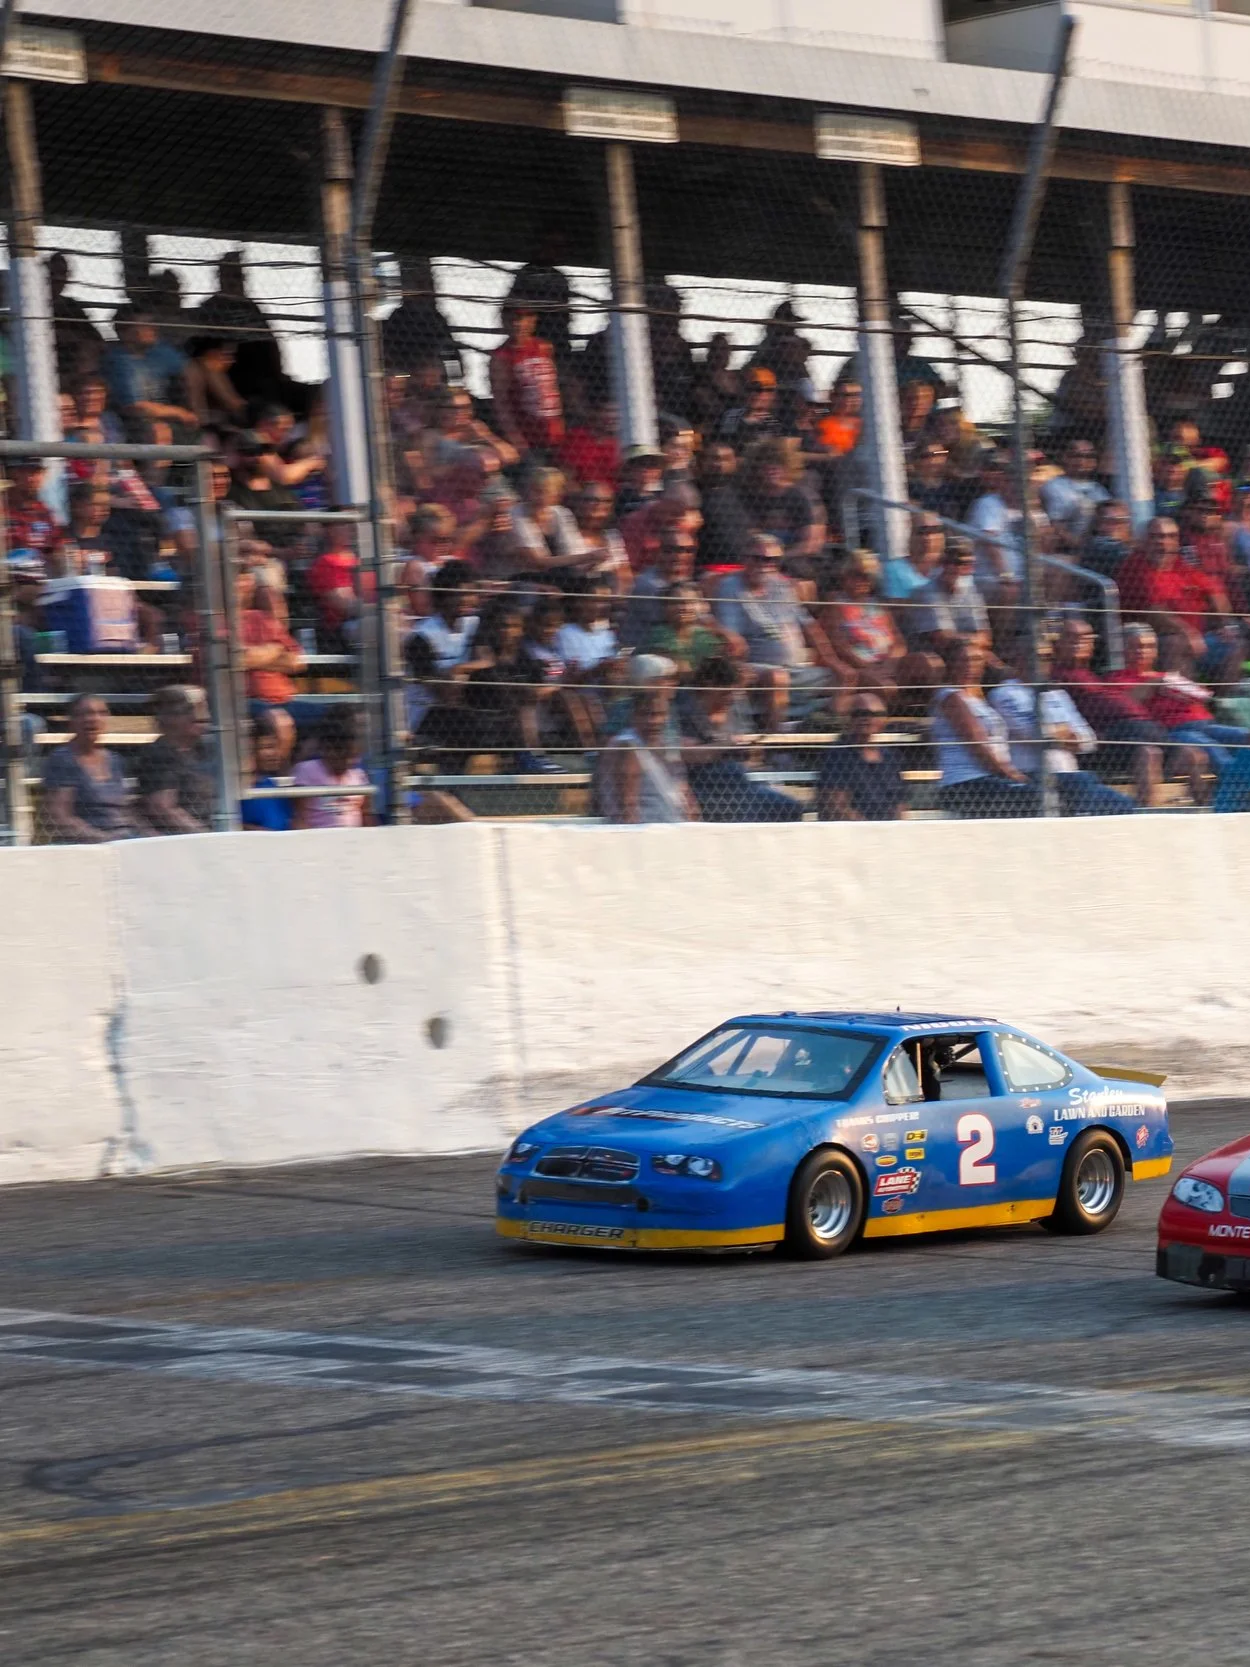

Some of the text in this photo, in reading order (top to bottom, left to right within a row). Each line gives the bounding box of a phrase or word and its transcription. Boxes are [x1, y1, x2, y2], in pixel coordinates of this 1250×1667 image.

[1054, 1104, 1145, 1121] LAWN AND GARDEN
[956, 1112, 997, 1187] 2
[528, 1221, 625, 1239] CHARGER
